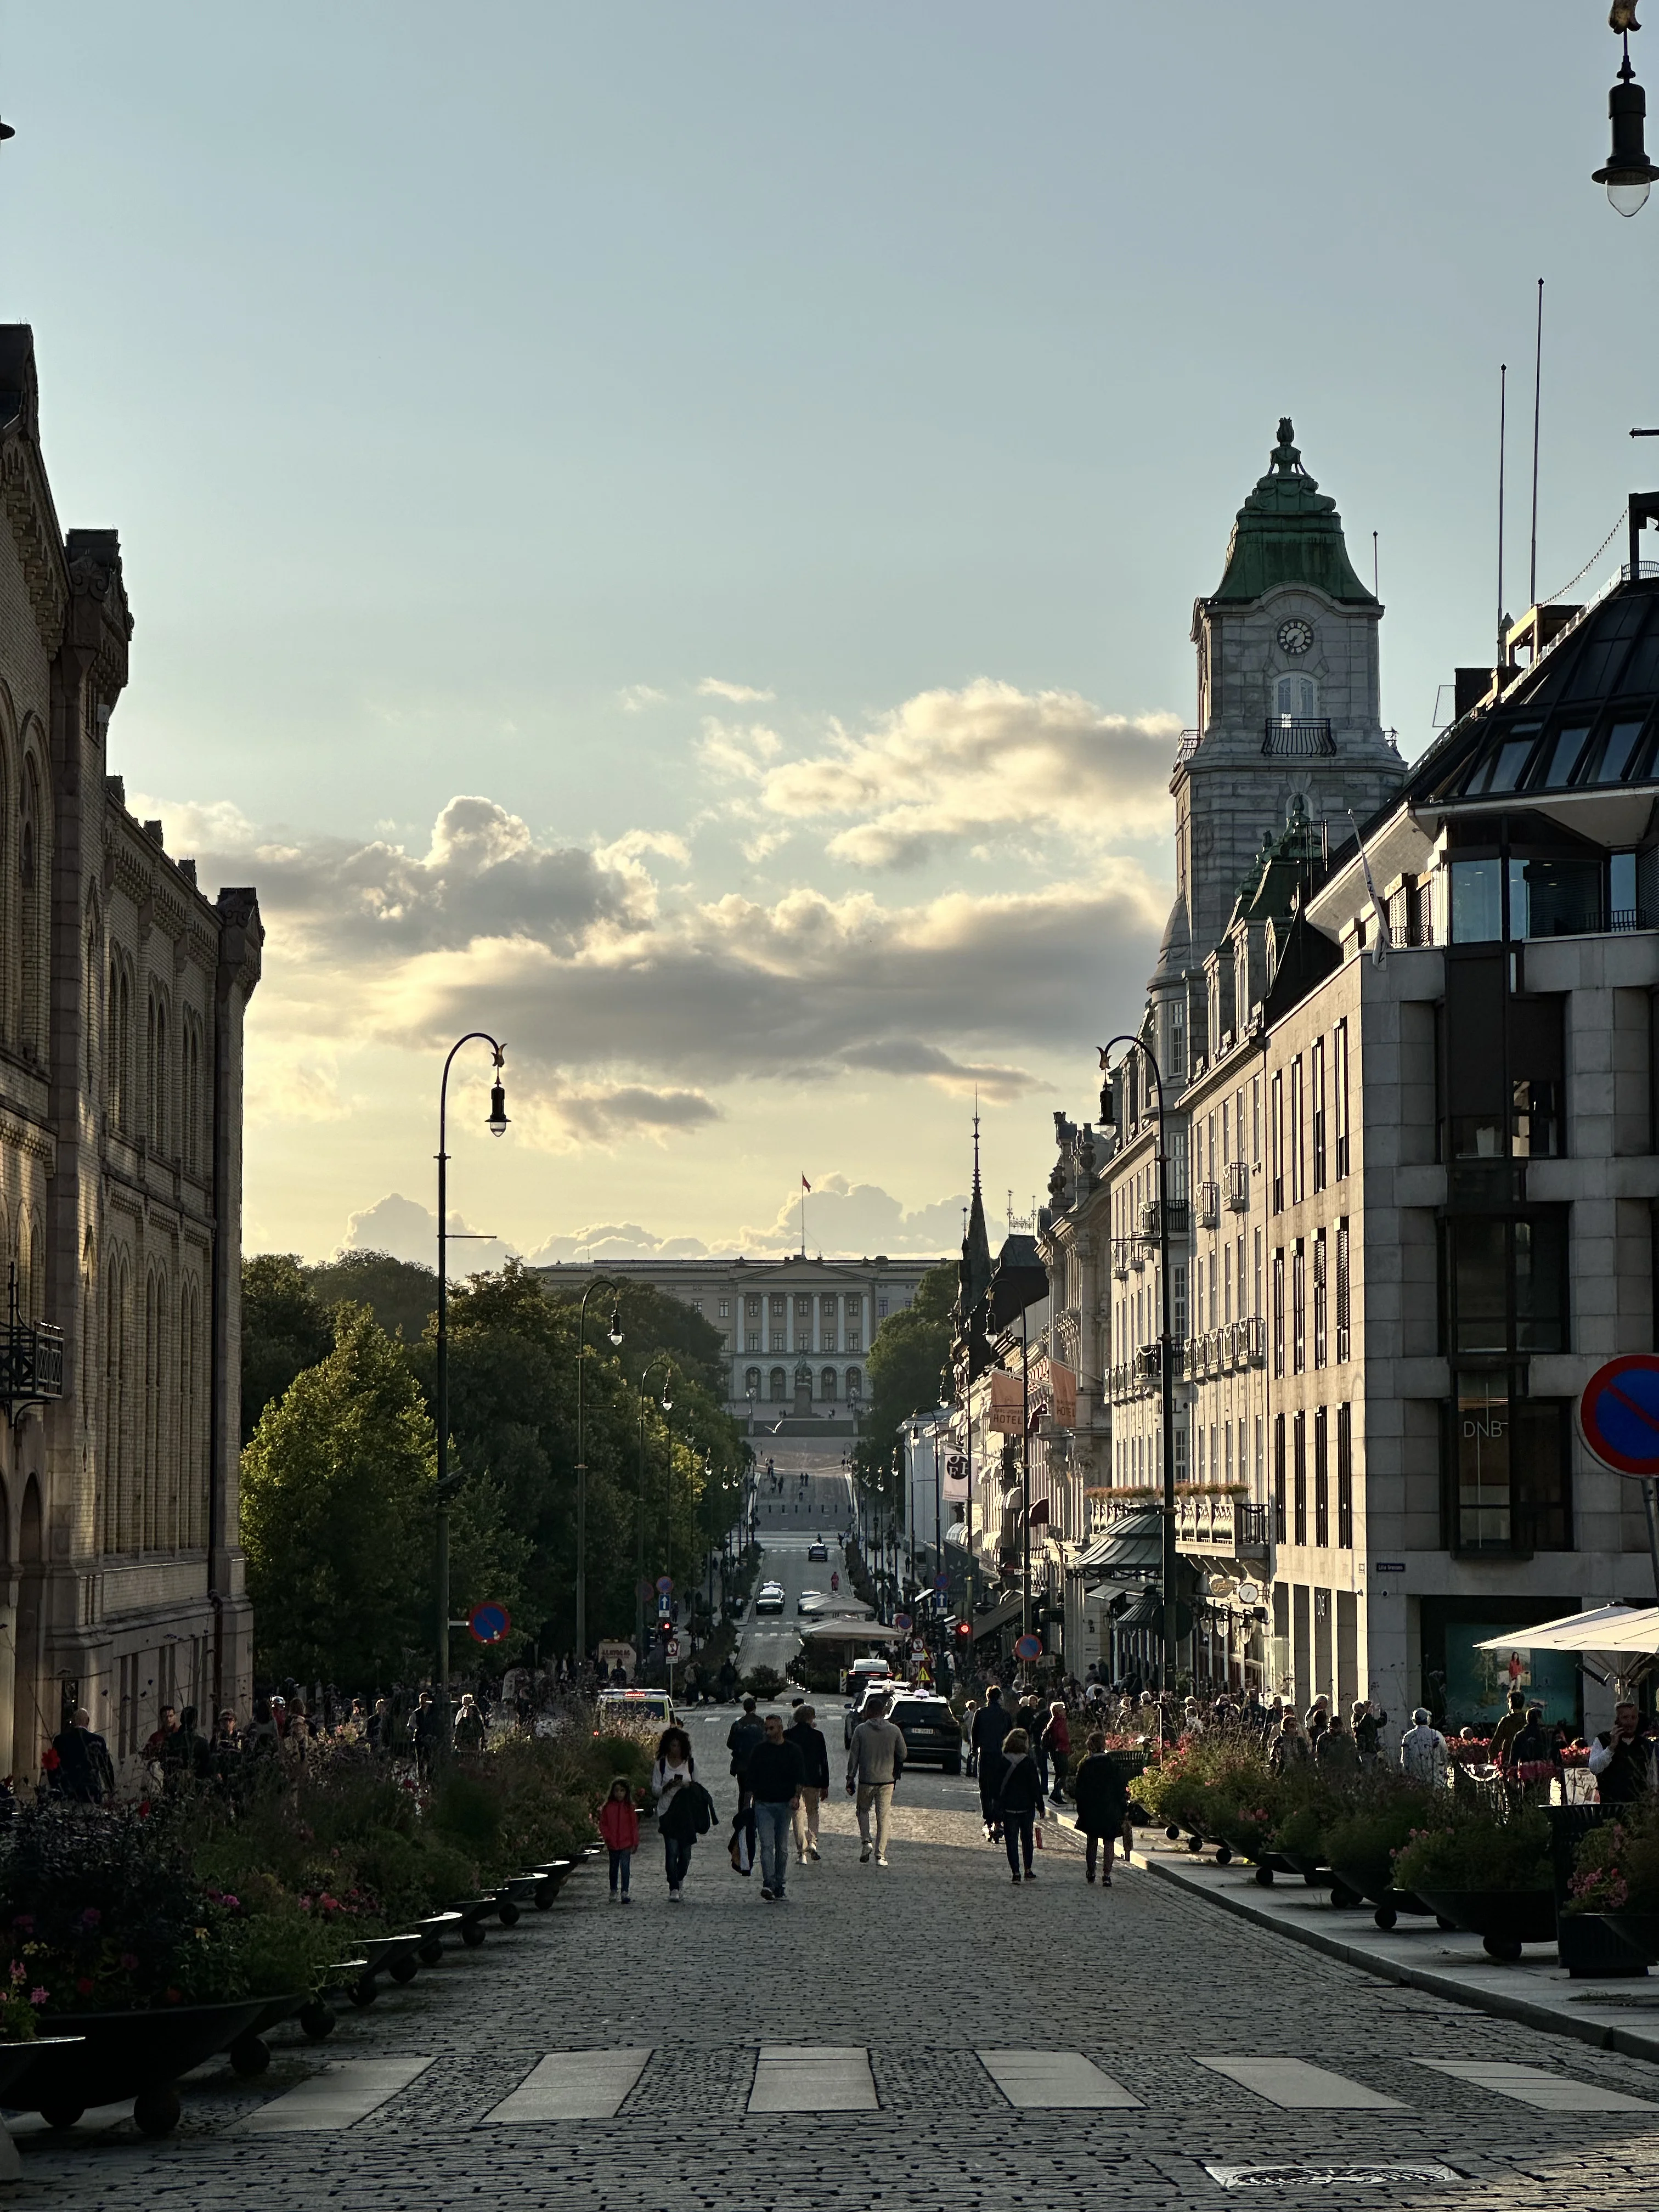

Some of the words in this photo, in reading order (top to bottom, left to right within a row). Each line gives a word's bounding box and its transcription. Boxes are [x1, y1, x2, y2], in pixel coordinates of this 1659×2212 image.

[1057, 1406, 1076, 1418] HOTEL
[994, 1414, 1023, 1424] HOTEL
[1464, 1420, 1502, 1437] DNB
